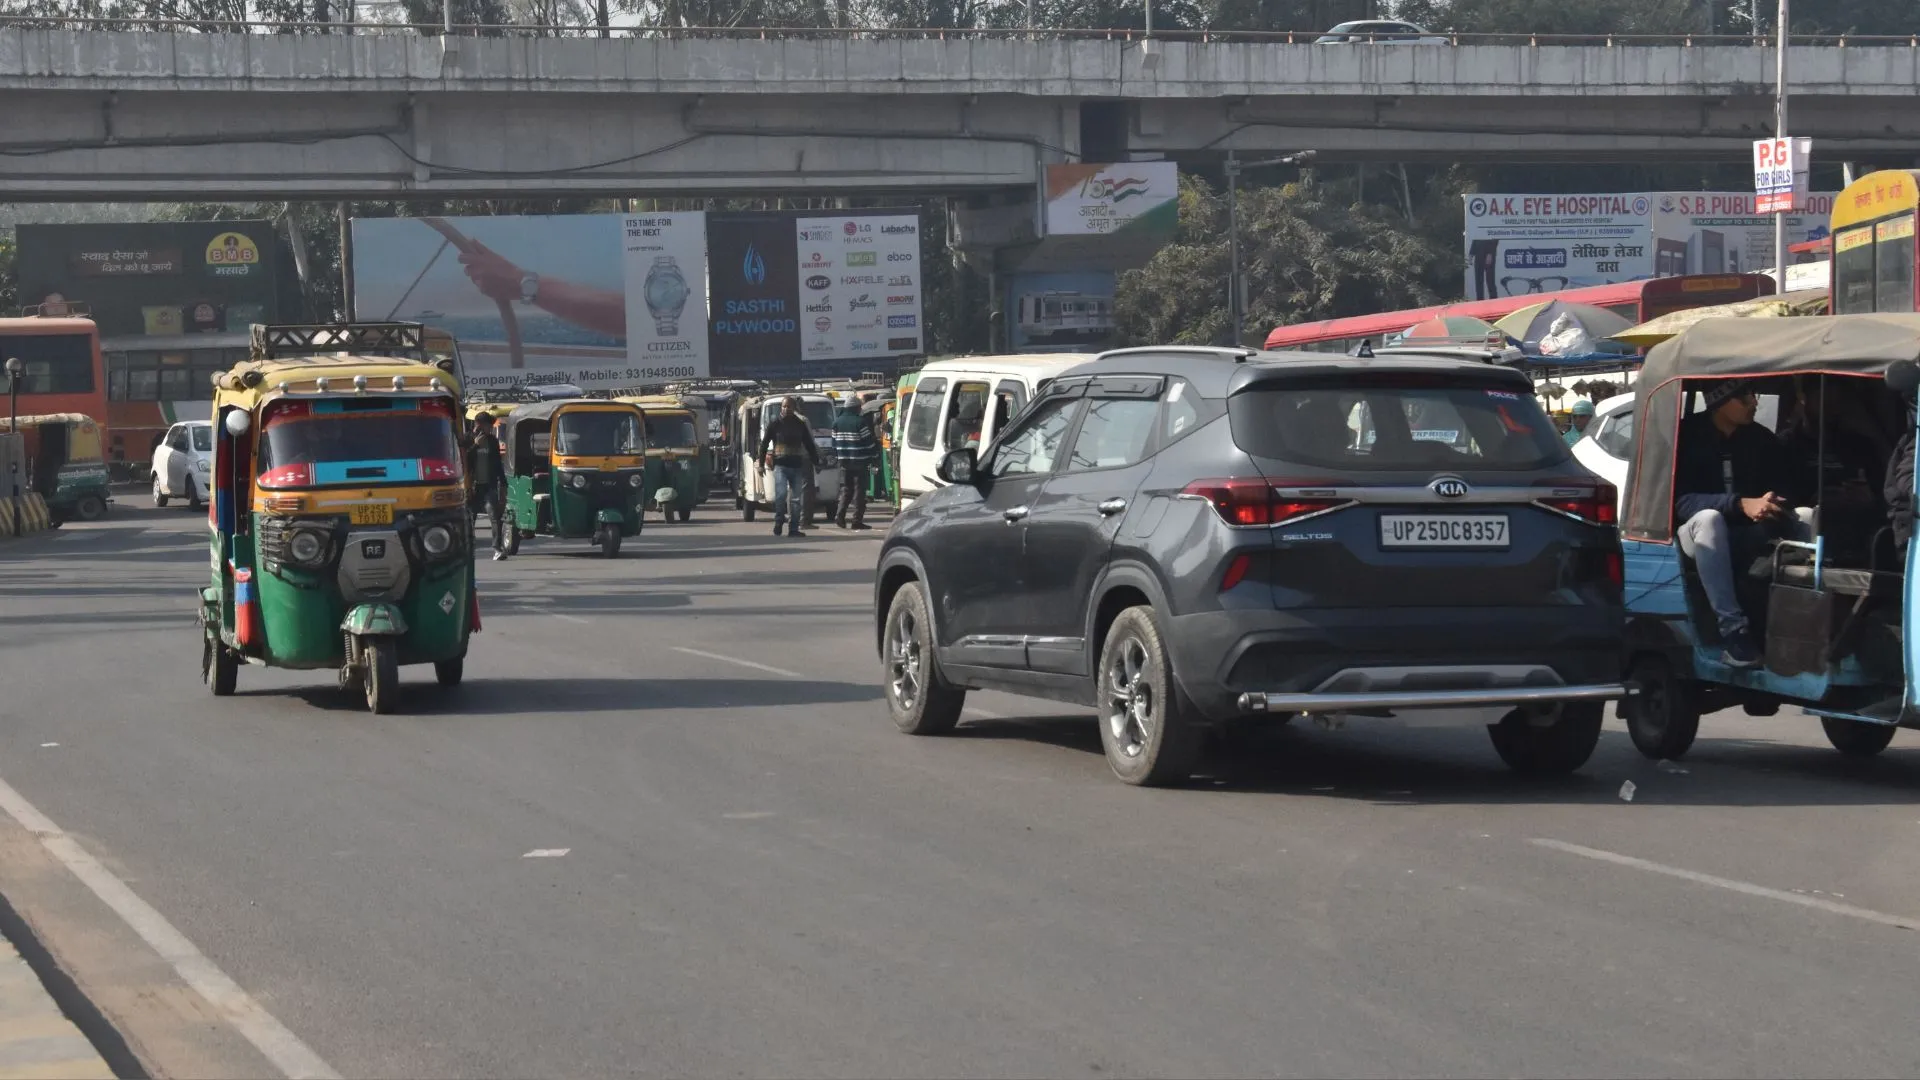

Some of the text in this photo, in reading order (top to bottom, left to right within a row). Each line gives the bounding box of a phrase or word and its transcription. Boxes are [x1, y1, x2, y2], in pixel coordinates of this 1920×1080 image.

[1758, 141, 1787, 168] P.G
[1756, 168, 1791, 187] FOR GIRLS
[1488, 196, 1631, 216] A.K. EYE HOSPITAL
[638, 218, 656, 227] TIME
[658, 218, 672, 226] FOR
[860, 224, 872, 232] LG
[627, 228, 660, 237] THE NEXT
[1572, 243, 1644, 258] लेसिक लेजर
[82, 252, 109, 262] स्वाद
[887, 252, 912, 262] ebco
[215, 264, 249, 276] मसाले
[808, 279, 829, 287] KAFF
[726, 299, 785, 314] SASTHI
[806, 304, 832, 312] Hettich
[716, 318, 796, 335] PLYWOOD
[648, 340, 691, 352] CITIZEN
[579, 369, 622, 382] Mobile:
[626, 366, 695, 380] 9319485000
[1440, 484, 1464, 494] KIA
[1394, 520, 1505, 541] UP25DC8357
